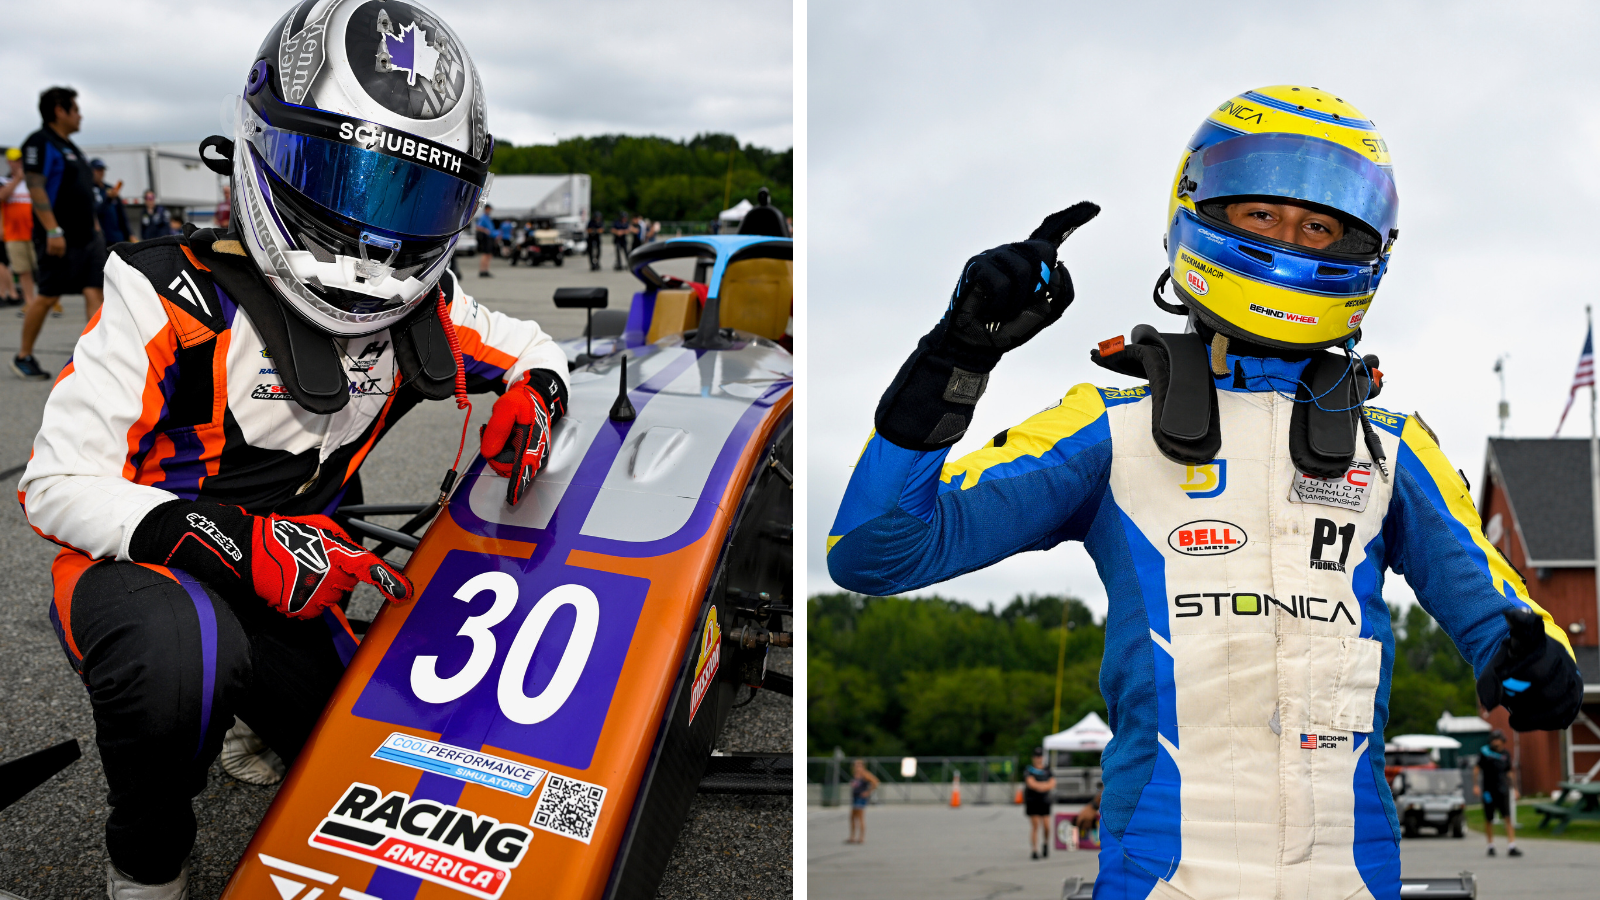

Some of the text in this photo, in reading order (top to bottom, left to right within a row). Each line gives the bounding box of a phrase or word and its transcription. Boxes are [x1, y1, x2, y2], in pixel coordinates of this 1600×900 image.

[338, 121, 462, 174] SCHUBERTH
[1188, 272, 1206, 292] BELL
[1249, 303, 1285, 319] BEHIND
[1285, 312, 1318, 324] WHEEL
[1298, 484, 1362, 501] FORMULA
[1299, 479, 1364, 494] JUNIOR
[1299, 491, 1361, 507] CHAMPIONSHIP
[1178, 528, 1237, 547] BELL
[1310, 517, 1356, 565] P1
[1174, 592, 1357, 626] STONICA
[410, 570, 600, 725] 30
[455, 767, 525, 792] SIMULATORS
[333, 786, 530, 863] RACING
[383, 843, 496, 889] AMERICA
